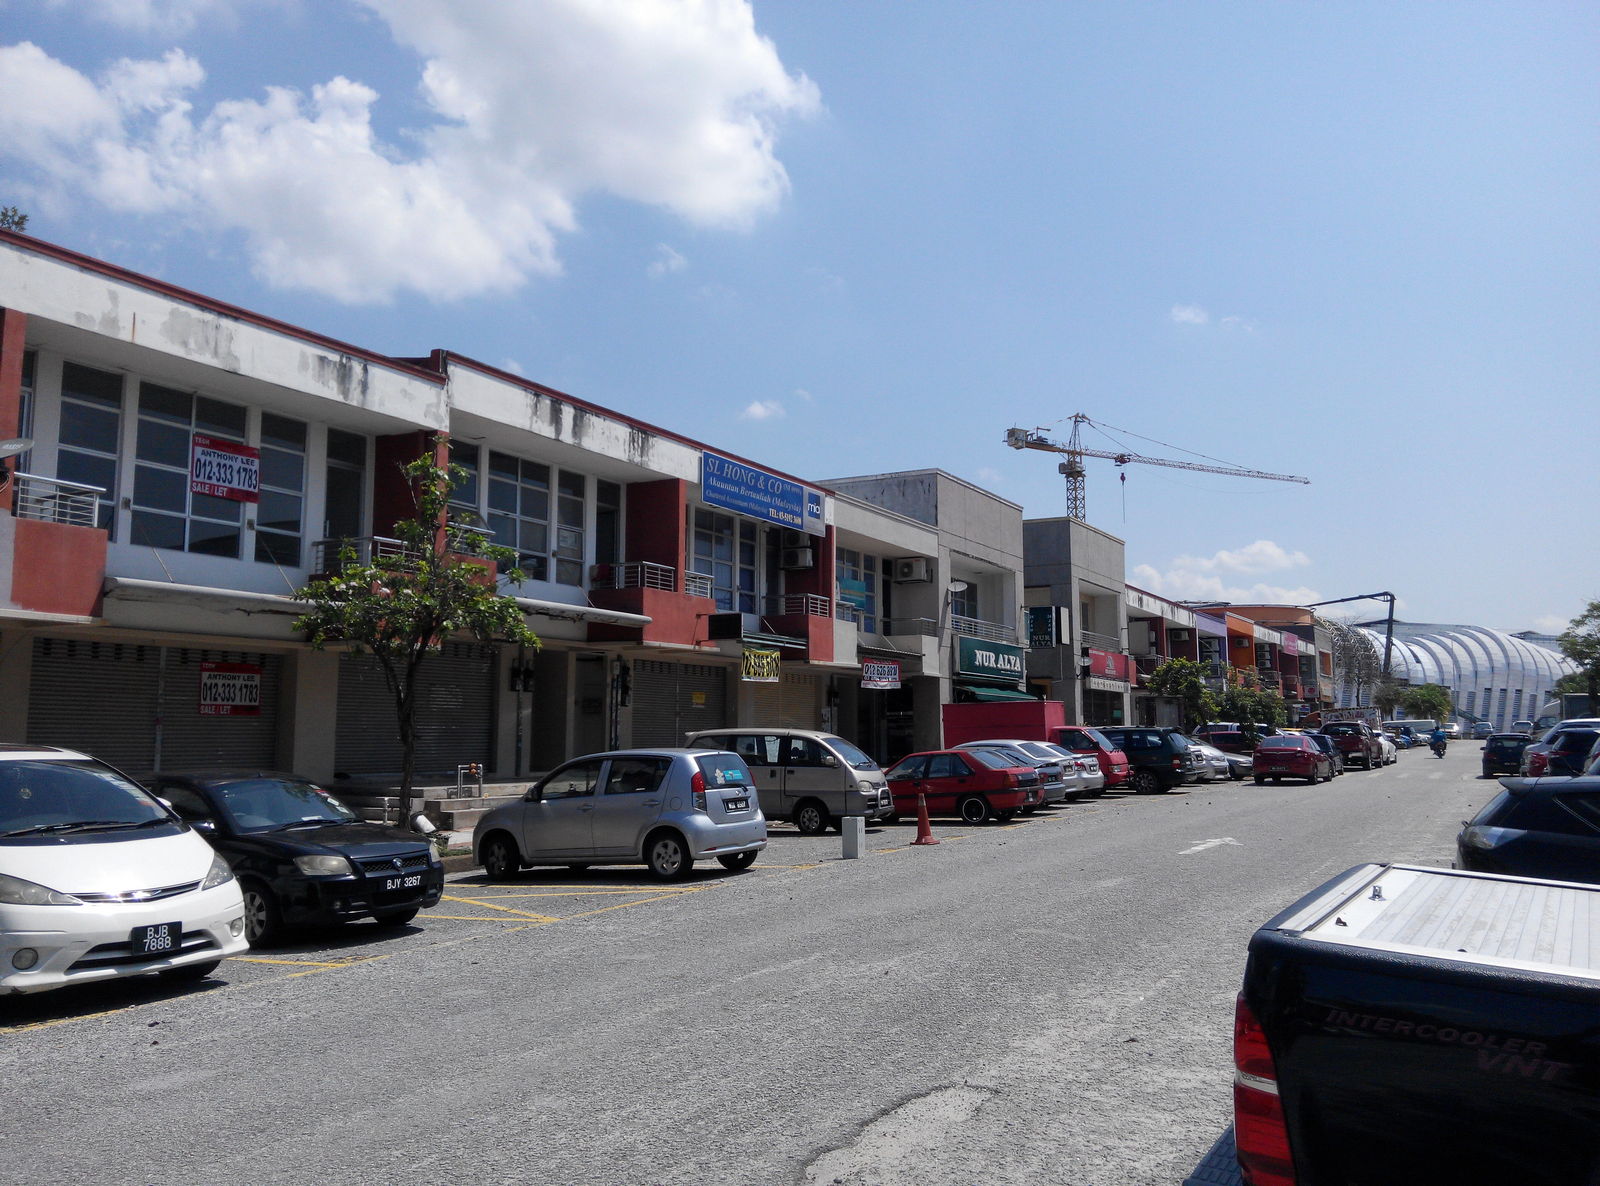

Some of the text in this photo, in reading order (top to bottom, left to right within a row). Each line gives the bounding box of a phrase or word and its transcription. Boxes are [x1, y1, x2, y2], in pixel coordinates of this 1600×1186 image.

[201, 449, 256, 467] ANTHONY LEE
[195, 458, 258, 490] 012-333 1783
[706, 458, 721, 475] SL
[723, 463, 756, 486] HONG
[757, 475, 765, 489] &
[768, 479, 782, 494] CO
[192, 482, 211, 494] SALE
[214, 486, 228, 497] LET
[974, 649, 1021, 672] NUR ALYA
[207, 673, 242, 681] ANTHONY
[202, 682, 258, 703] 012-333 1783
[386, 875, 421, 890] BJY 3267
[147, 925, 169, 939] BJB
[143, 936, 172, 952] 7888
[1324, 1009, 1548, 1055] INTERCOOLER
[1477, 1048, 1576, 1081] VNT
